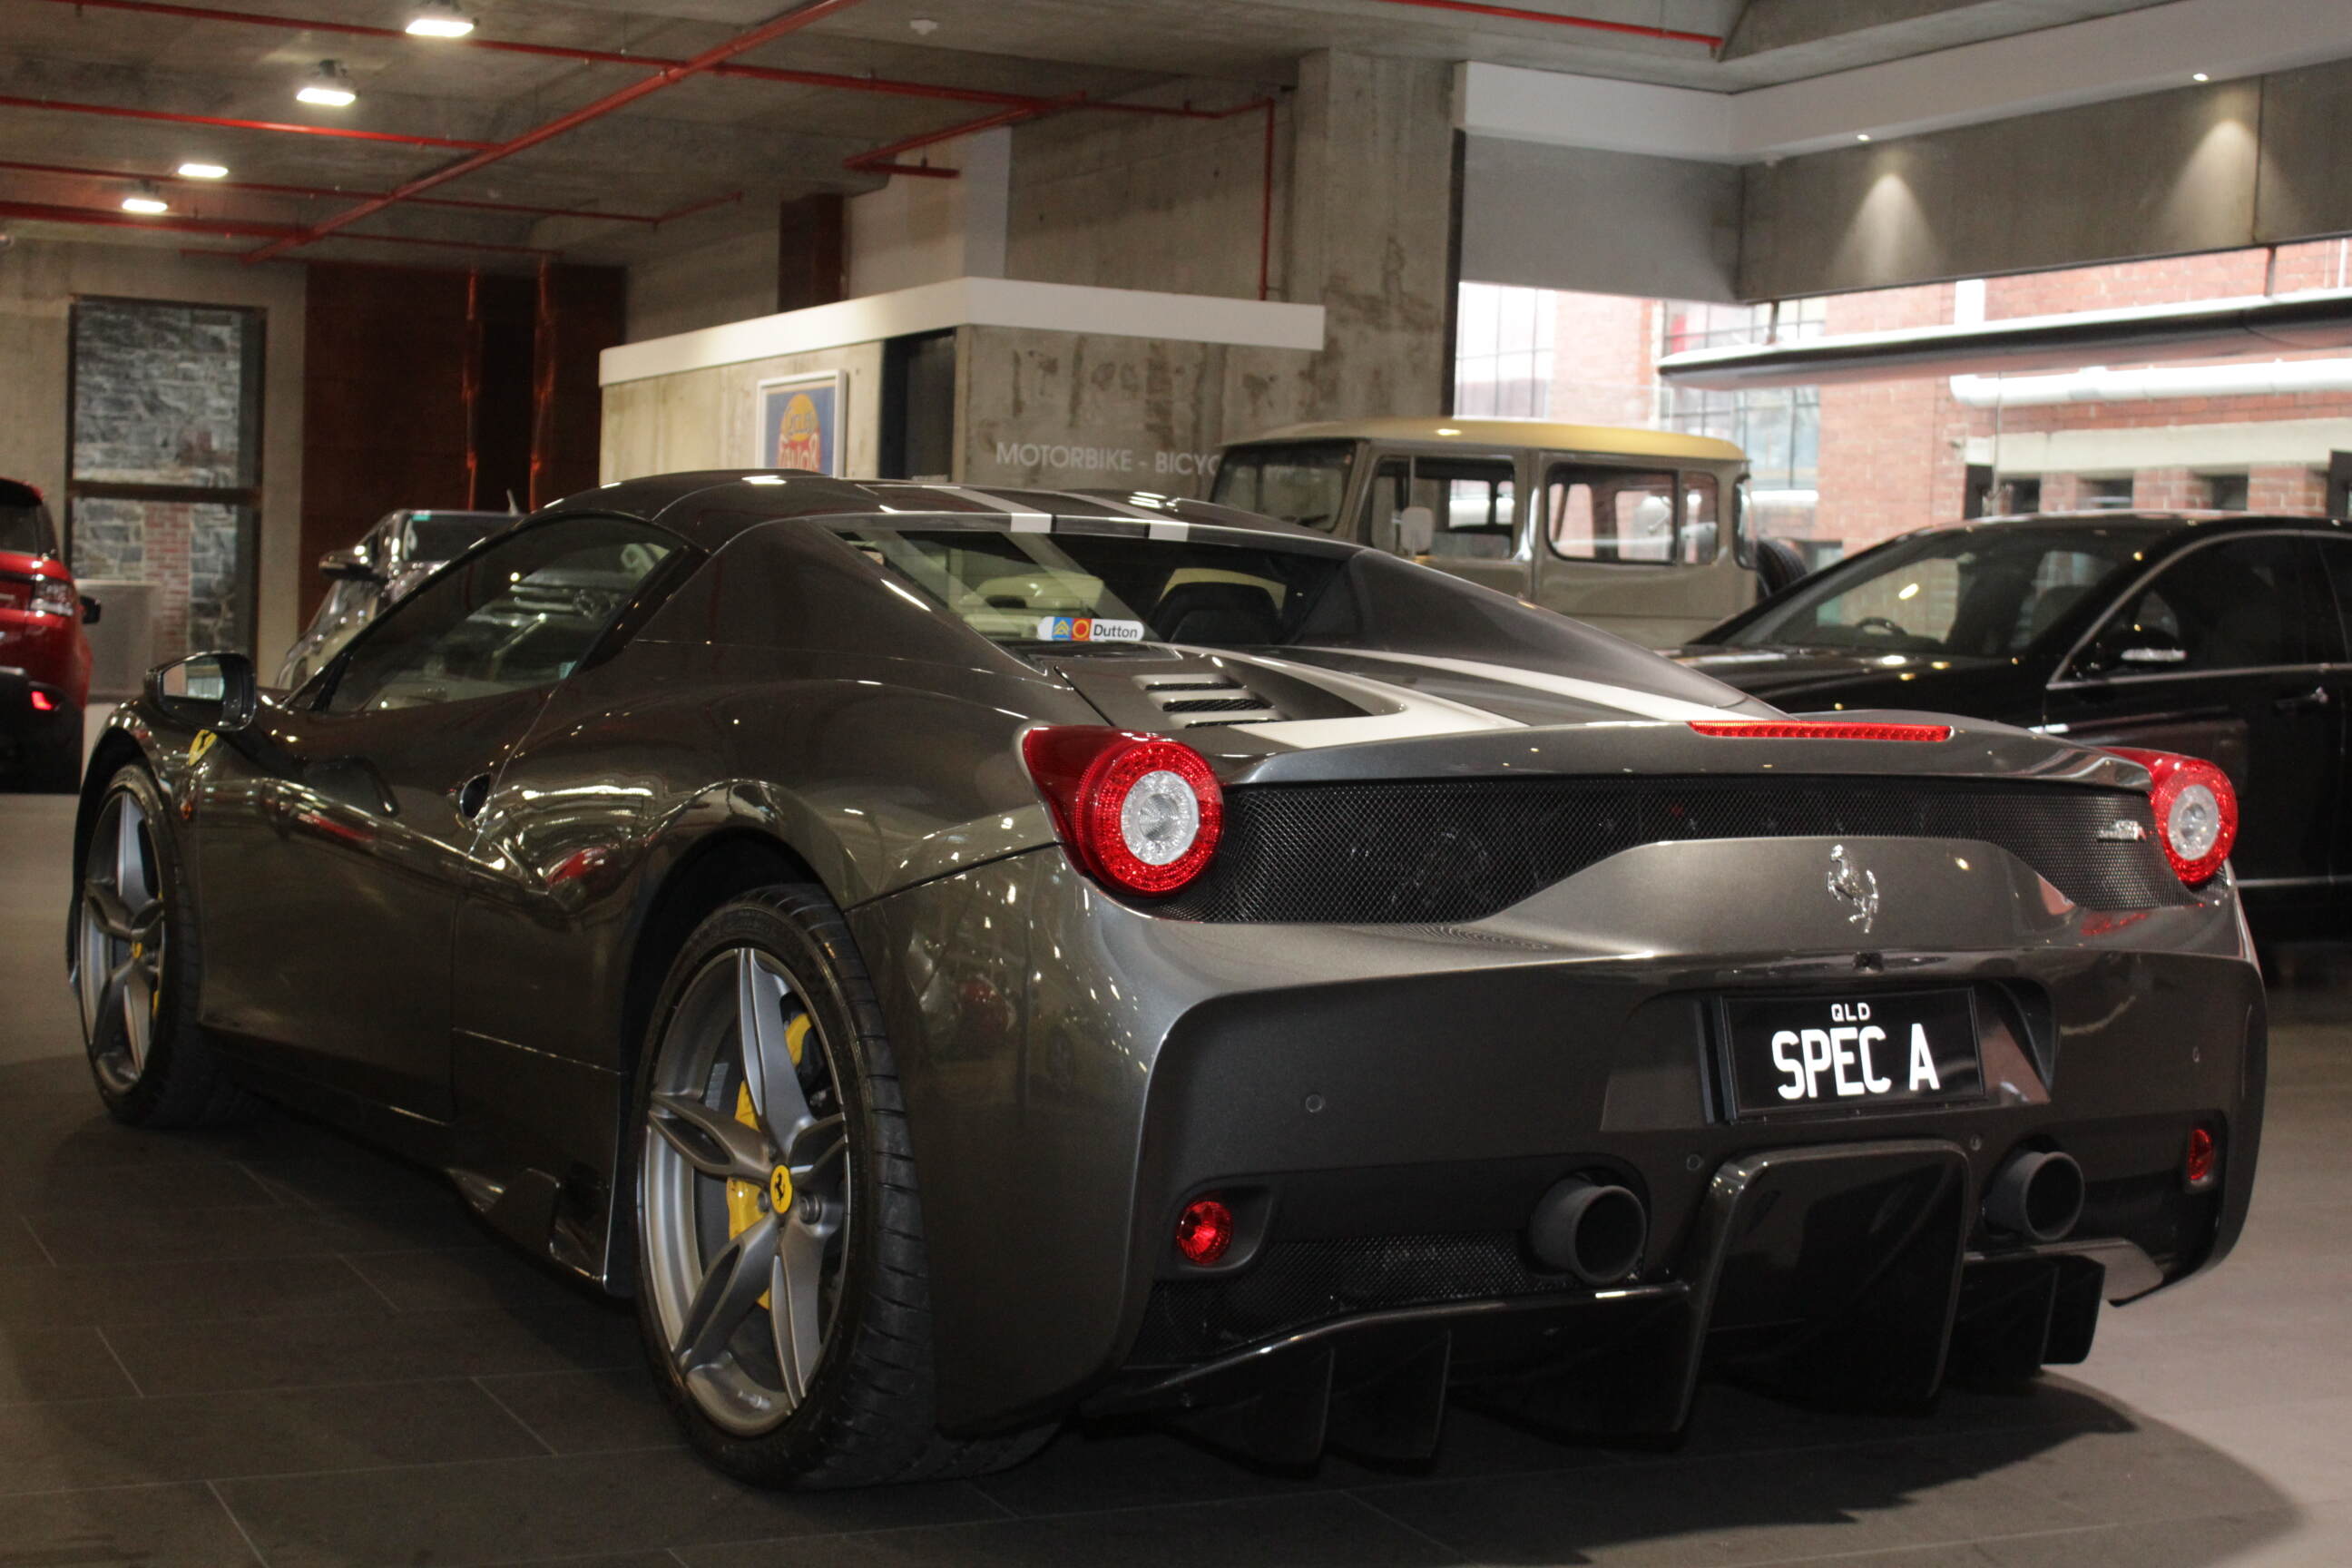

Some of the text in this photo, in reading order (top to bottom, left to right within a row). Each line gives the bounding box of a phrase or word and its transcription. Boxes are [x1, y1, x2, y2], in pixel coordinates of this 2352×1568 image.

[996, 442, 1132, 472] MOTORBIKE
[1093, 624, 1138, 638] Dutton
[1830, 1003, 1871, 1022] QLD
[1771, 1023, 1940, 1100] SPEC A
